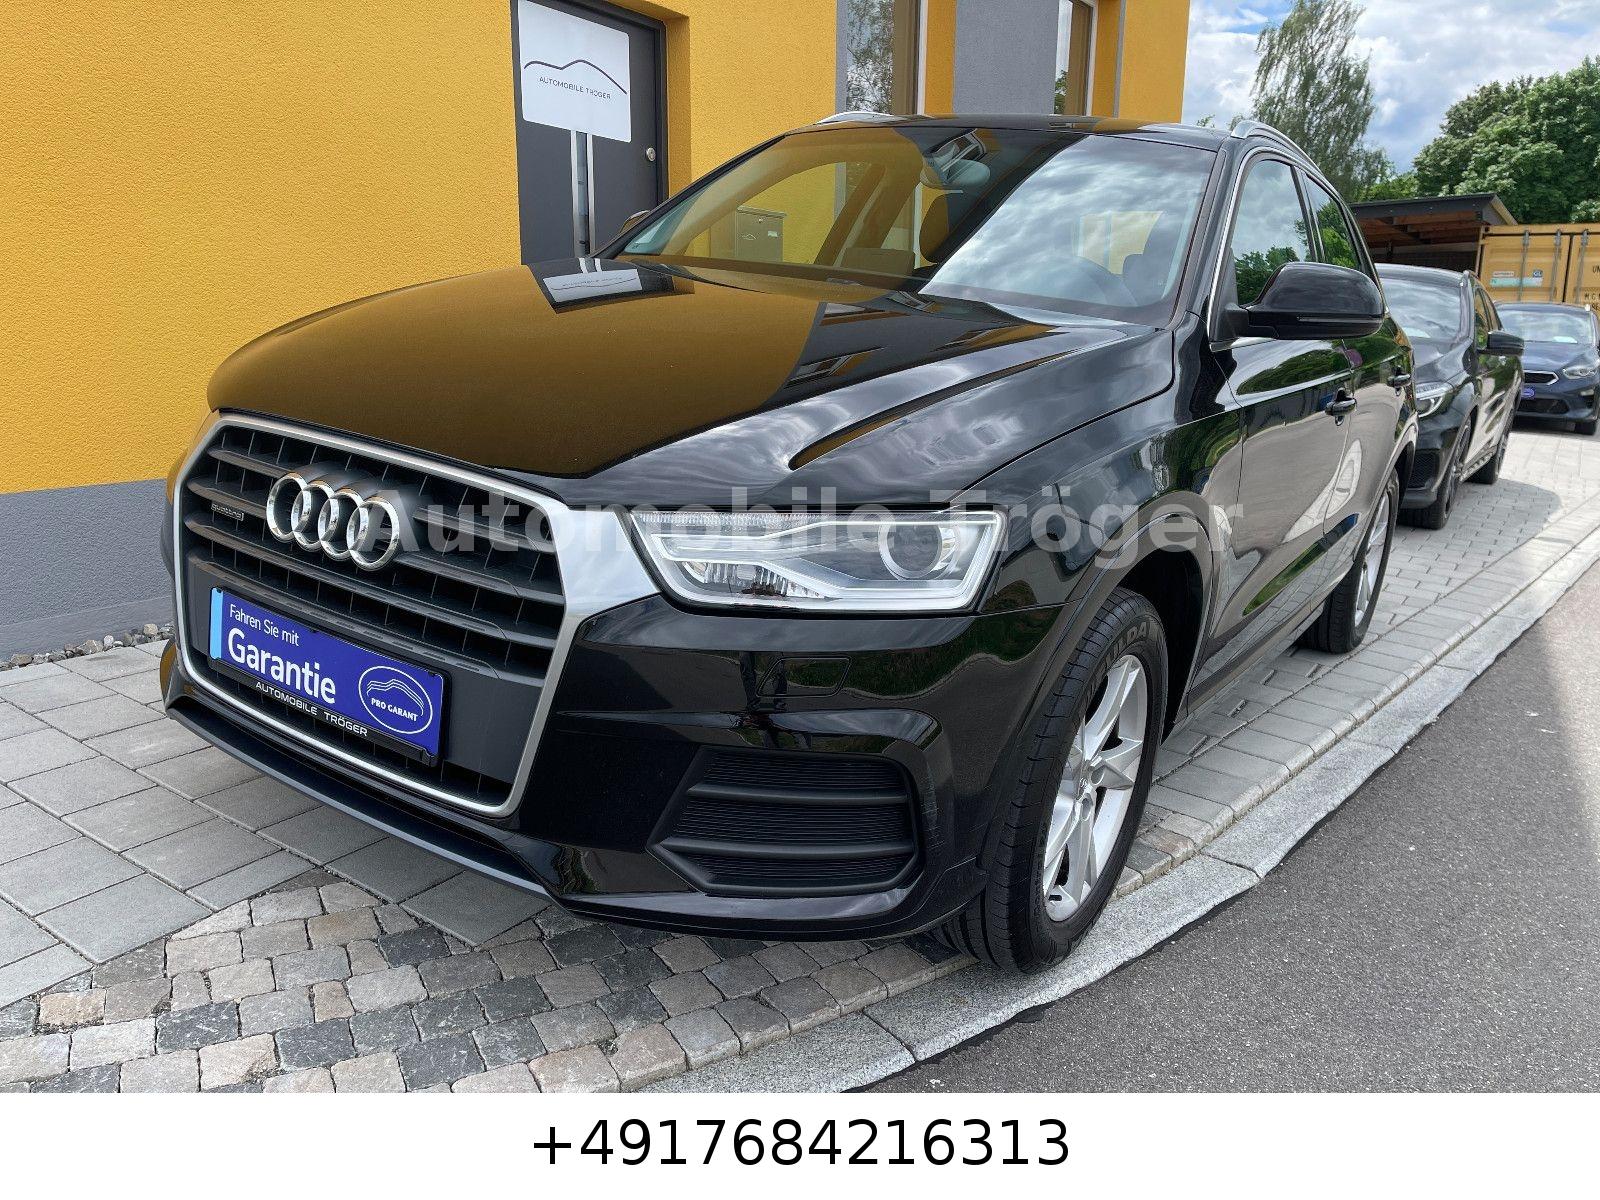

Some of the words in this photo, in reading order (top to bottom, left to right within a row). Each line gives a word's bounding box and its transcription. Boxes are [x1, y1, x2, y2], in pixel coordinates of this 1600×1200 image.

[539, 76, 584, 93] AUTOMOBILE
[229, 603, 261, 631] Fahren
[263, 619, 280, 638] Sie
[281, 629, 300, 647] mit
[228, 627, 336, 704] Garantie
[255, 681, 318, 716] AUTOMOBILE
[323, 711, 368, 737] TRÖGER
[371, 697, 387, 711] PRO
[388, 703, 418, 722] GARANT
